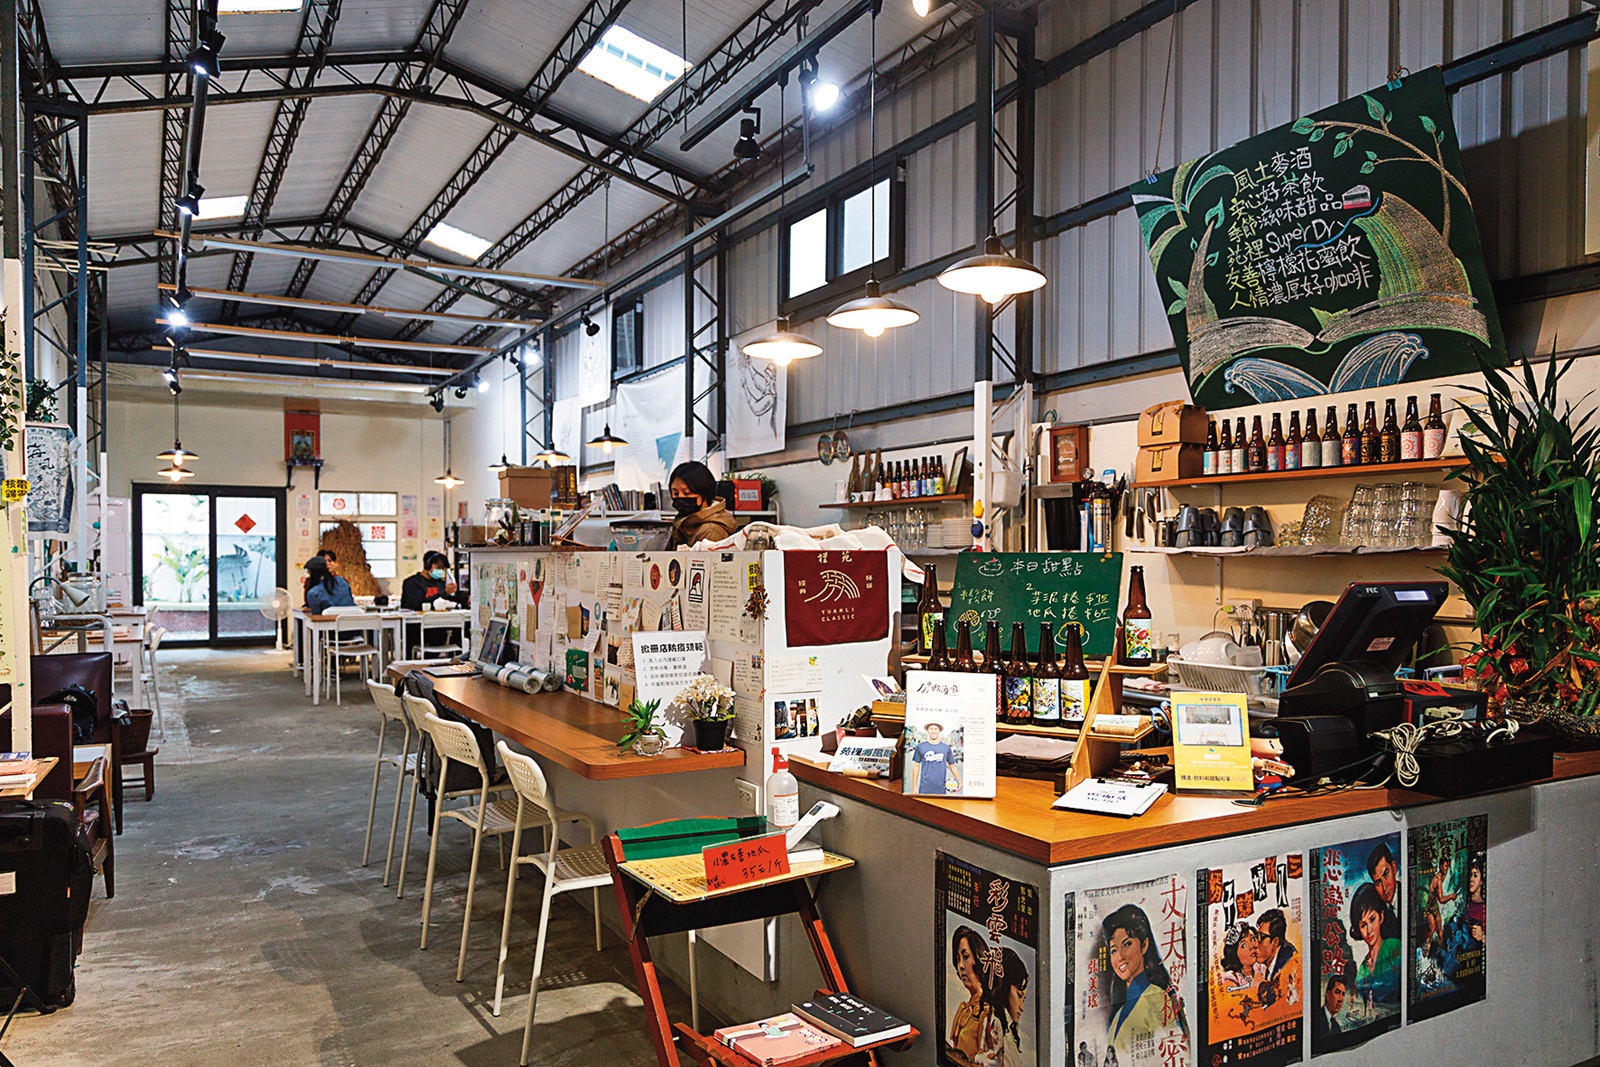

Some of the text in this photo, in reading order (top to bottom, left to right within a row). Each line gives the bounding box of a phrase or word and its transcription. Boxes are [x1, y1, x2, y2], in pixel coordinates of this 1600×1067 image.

[1234, 146, 1312, 196] 風土麥酒
[1229, 171, 1327, 220] 安心好茶飲
[1228, 193, 1343, 242] 季節滋味甜品
[1266, 222, 1311, 254] Super
[1010, 557, 1084, 577] 本日甜點
[821, 607, 855, 615] YUANLI
[821, 614, 856, 622] CLASSIC
[978, 877, 1010, 990] 彩雲飛
